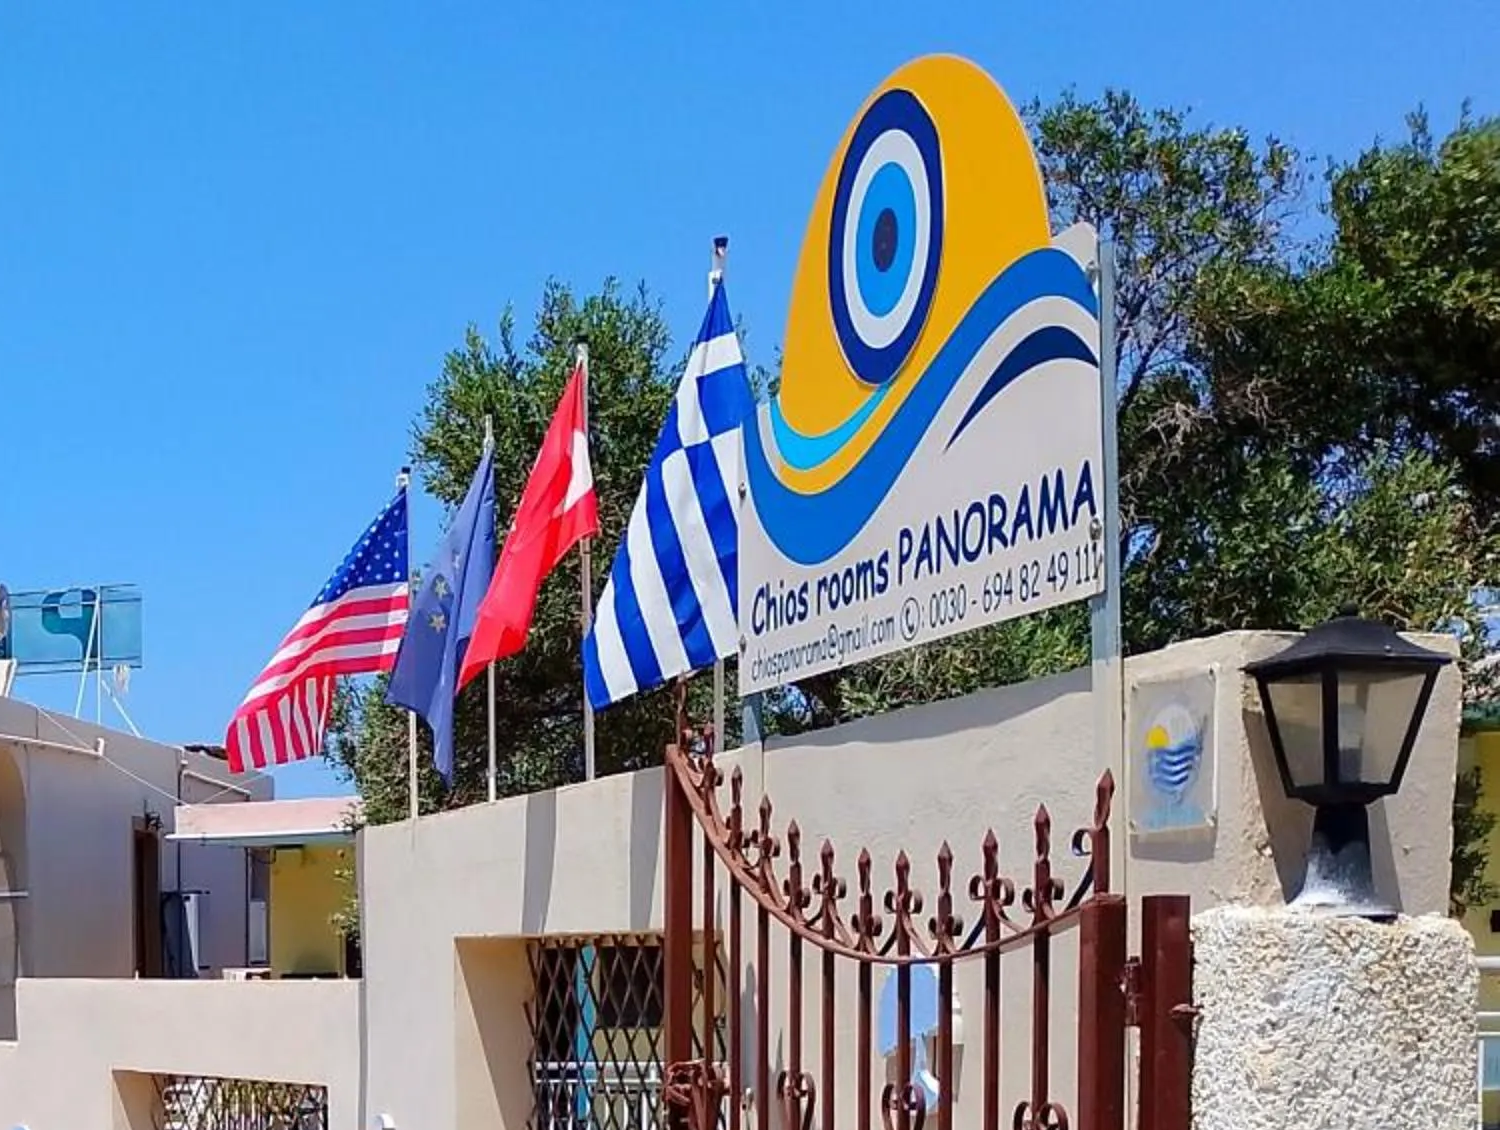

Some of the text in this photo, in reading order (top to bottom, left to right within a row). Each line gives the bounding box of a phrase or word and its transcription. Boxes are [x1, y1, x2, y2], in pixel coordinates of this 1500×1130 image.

[751, 459, 1097, 636] Chios rooms PANORAMA
[751, 614, 895, 683] chiospanorama@gmail.com
[929, 583, 967, 629] 0030
[983, 567, 1013, 614] 694
[1019, 560, 1040, 602] 82
[1046, 551, 1069, 593] 49
